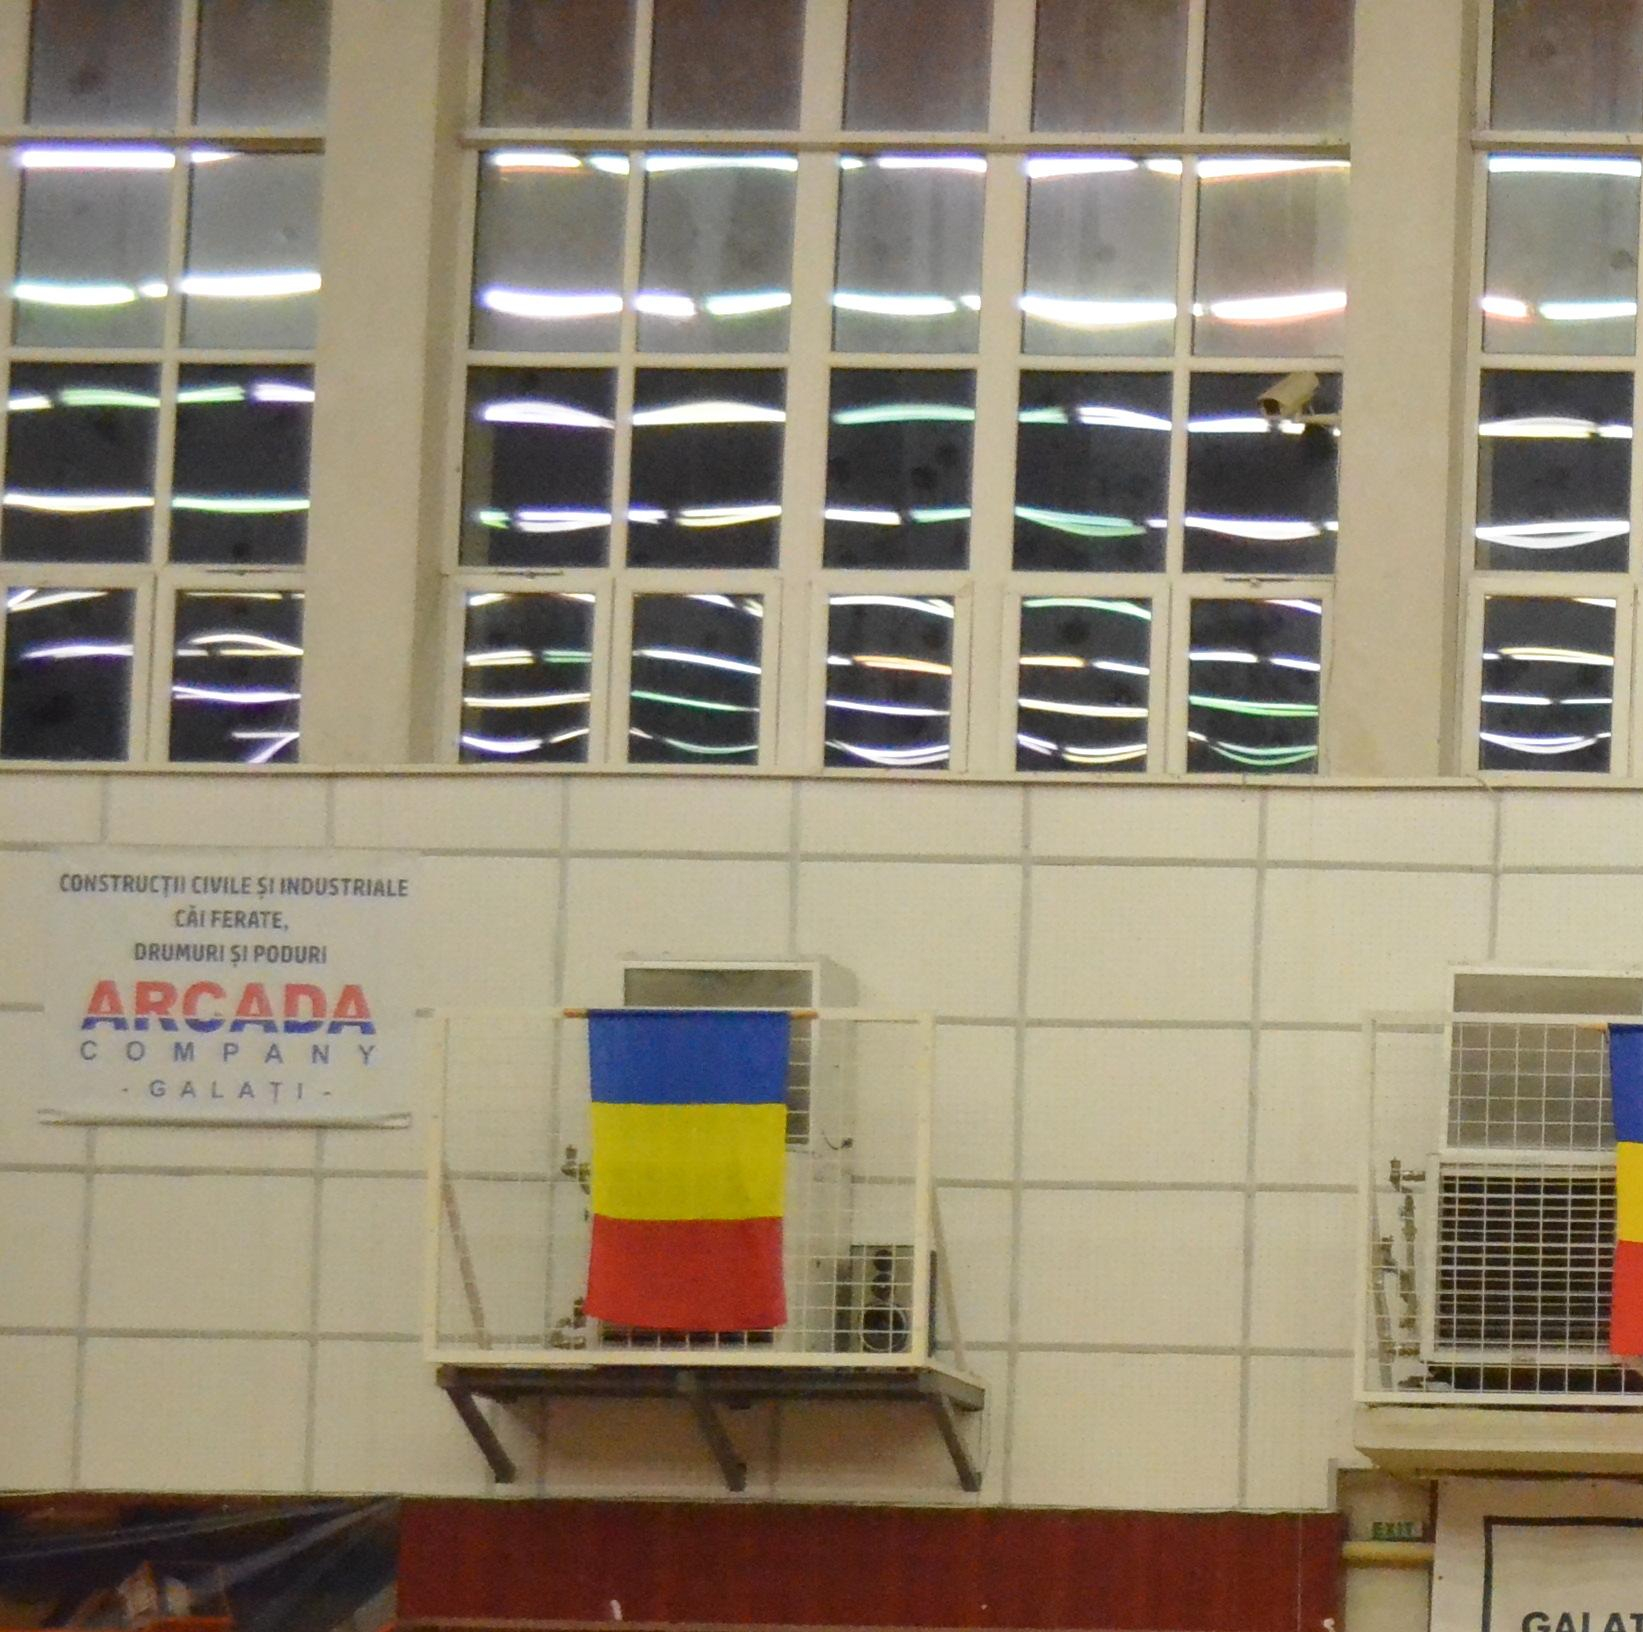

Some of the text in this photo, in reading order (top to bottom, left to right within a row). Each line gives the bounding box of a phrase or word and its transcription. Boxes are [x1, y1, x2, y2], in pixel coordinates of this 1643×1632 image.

[59, 873, 410, 899] CONSTRUCȚII CIVILE ȘI INDUSTRIALE
[174, 905, 289, 931] CĂI FERATE,
[134, 942, 327, 967] DRUMURI ȘI PODURI
[81, 980, 377, 1035] ARCADA
[80, 1040, 376, 1065] COMPANY
